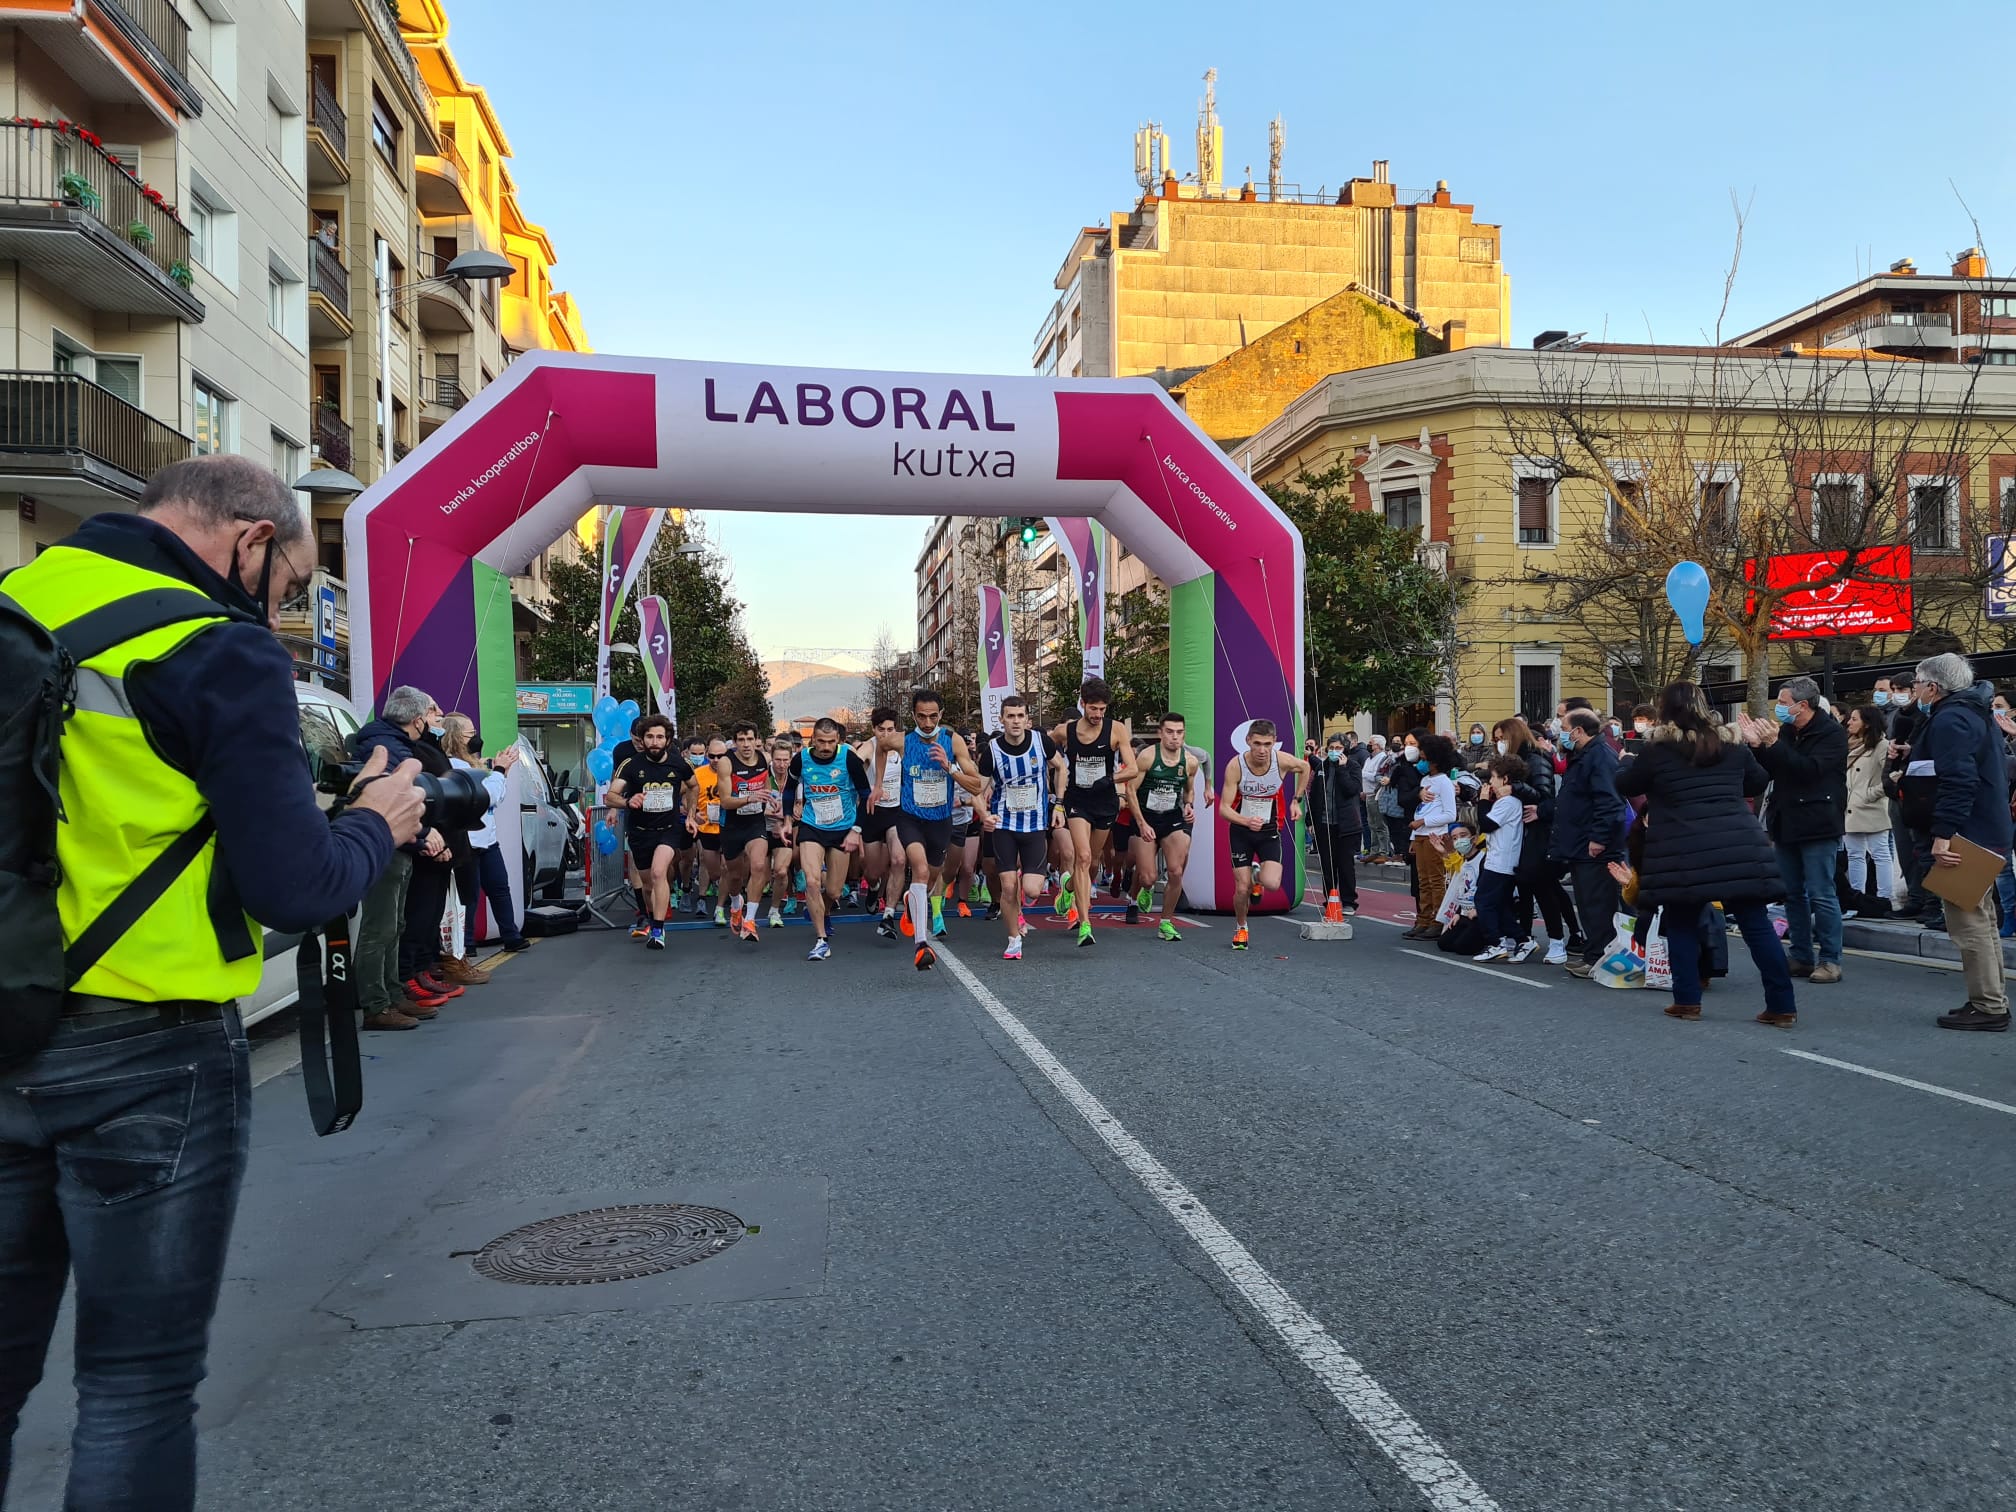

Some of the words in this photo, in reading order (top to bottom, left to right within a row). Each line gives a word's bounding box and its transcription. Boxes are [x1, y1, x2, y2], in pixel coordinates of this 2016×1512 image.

[704, 377, 1016, 432] LABORAL
[439, 485, 476, 515] banka
[471, 431, 540, 489] kooperatiboa
[893, 442, 1015, 478] kutxa
[1162, 454, 1190, 485] banca
[1188, 482, 1238, 531] cooperativa
